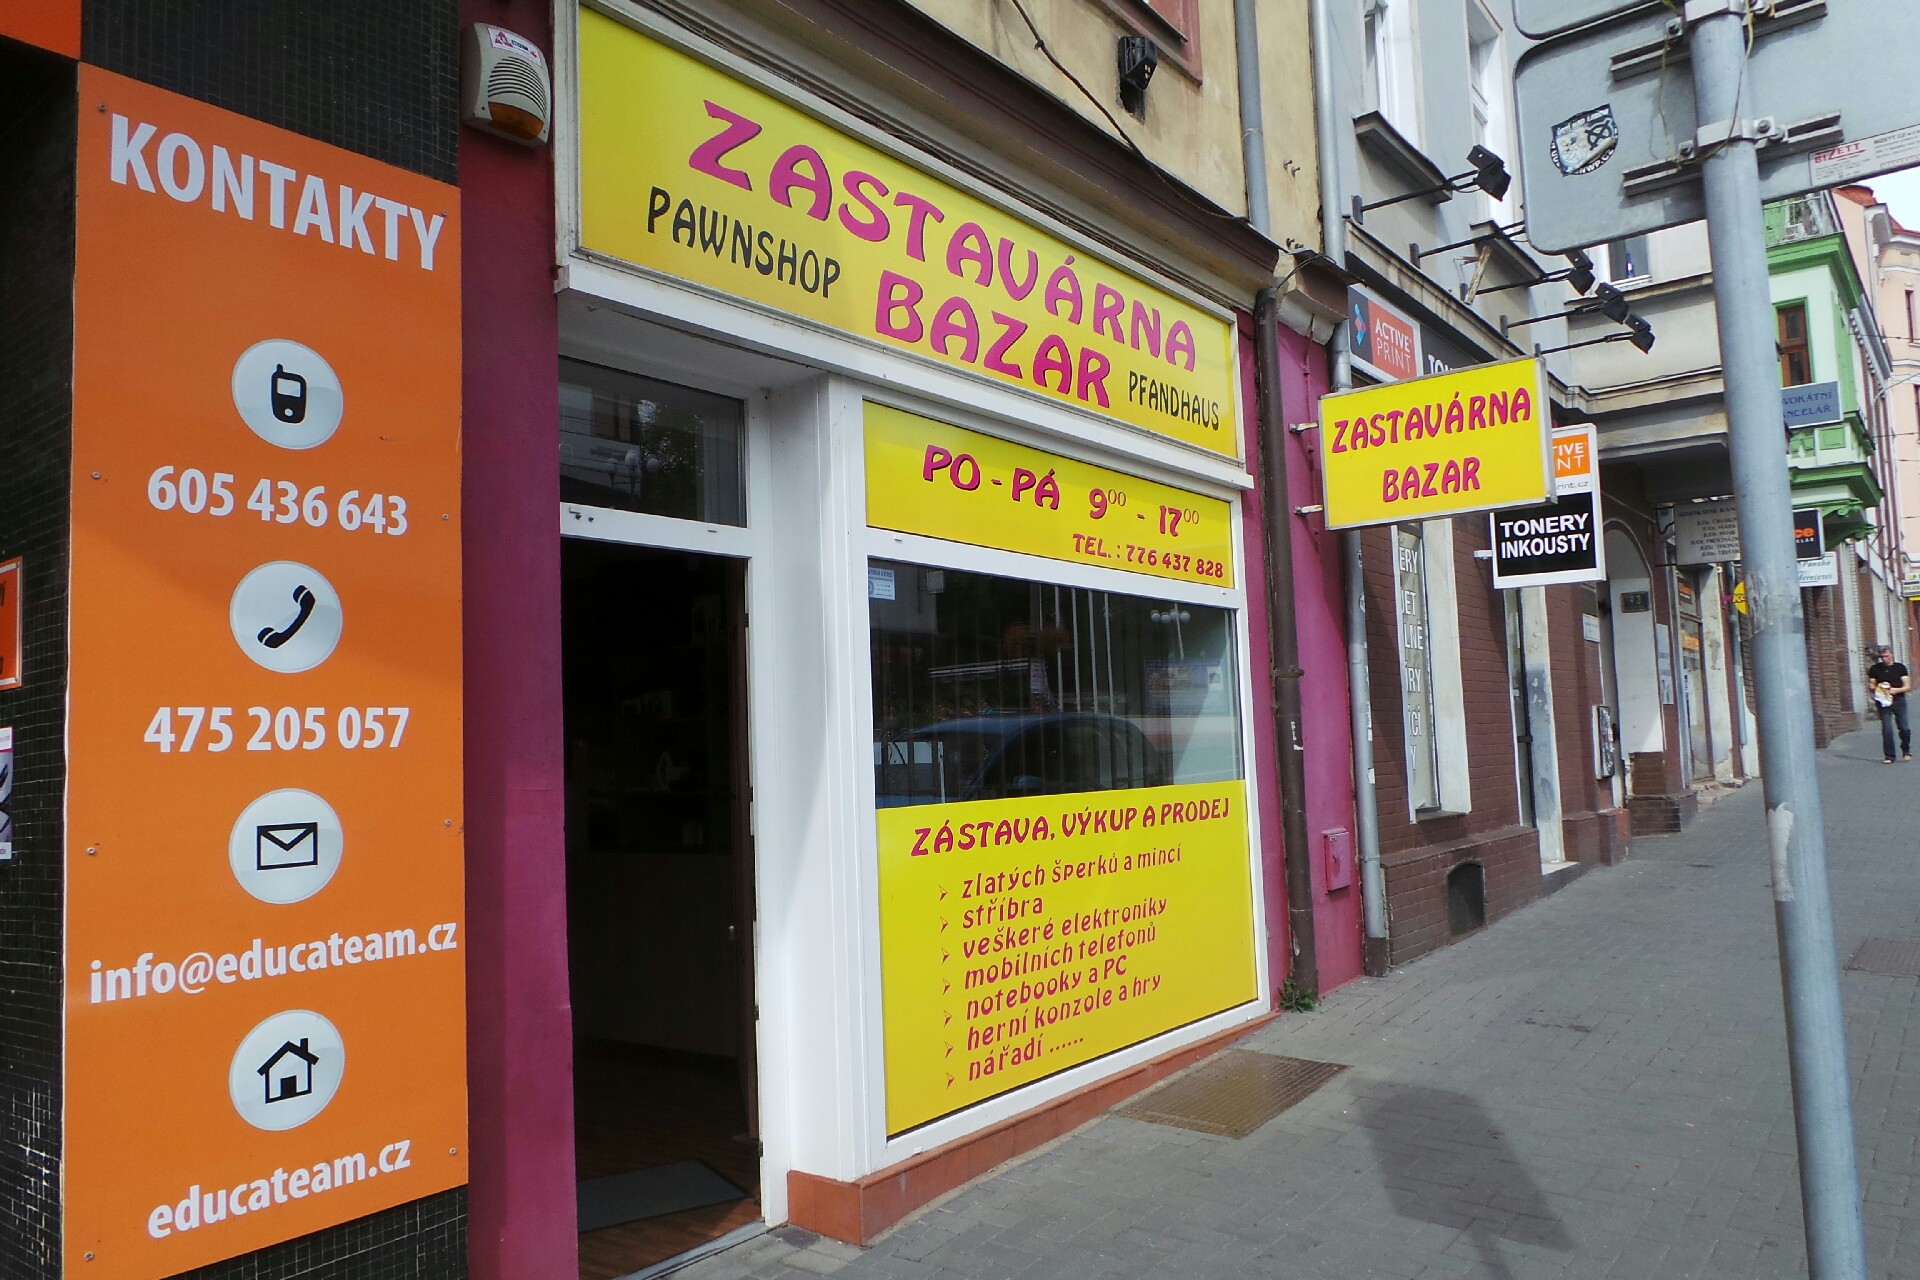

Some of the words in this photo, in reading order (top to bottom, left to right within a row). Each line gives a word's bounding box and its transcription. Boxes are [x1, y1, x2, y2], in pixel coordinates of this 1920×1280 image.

[109, 113, 444, 271] KONTAKTY
[647, 186, 841, 300] PAWNSHOP
[689, 99, 1196, 373] ZASTAVÁRNA
[876, 269, 1111, 409] BAZAR
[1375, 317, 1411, 353] ACTIVE
[1376, 337, 1411, 374] PRINT
[1127, 371, 1220, 432] PFANDHAUS
[1331, 387, 1531, 454] ZASTAVÁRNA
[148, 466, 235, 517] 605
[247, 478, 329, 529] 436
[338, 490, 408, 537] 643
[923, 444, 981, 492] PO
[1012, 468, 1060, 511] PÁ
[1383, 456, 1481, 503] BAZAR
[1500, 512, 1589, 538] TONERY
[1501, 532, 1591, 560] INKOUSTY
[1126, 544, 1158, 567] 776
[1162, 552, 1191, 573] 437
[1196, 558, 1224, 579] 828
[1400, 546, 1418, 575] ERY
[144, 706, 234, 753] 475
[246, 705, 327, 752] 205
[337, 706, 410, 750] 057
[911, 816, 1056, 857] ZÁSTAVA,
[1061, 806, 1138, 838] VÝKUP
[1143, 813, 1156, 828] A
[1160, 797, 1230, 826] PRODEJ
[961, 864, 1046, 900] zlatých
[1051, 852, 1118, 885] šperků
[1123, 855, 1133, 871] a
[1137, 843, 1182, 869] mincí
[962, 896, 1043, 930] stříbra
[963, 920, 1054, 960] veškeré
[1061, 897, 1168, 936] elektroniky
[90, 921, 458, 1004] info@educateam.cz
[964, 943, 1074, 990] mobilních
[1078, 921, 1157, 961] telefonů
[966, 970, 1081, 1021] notebooky
[1088, 968, 1098, 983] a
[1103, 954, 1128, 981] PC
[967, 1014, 1028, 1052] herní
[1034, 987, 1112, 1030] konzole
[1118, 985, 1128, 1001] a
[1132, 973, 1161, 998] hry
[968, 1033, 1043, 1082] nářadí
[147, 1139, 412, 1239] educateam.cz
